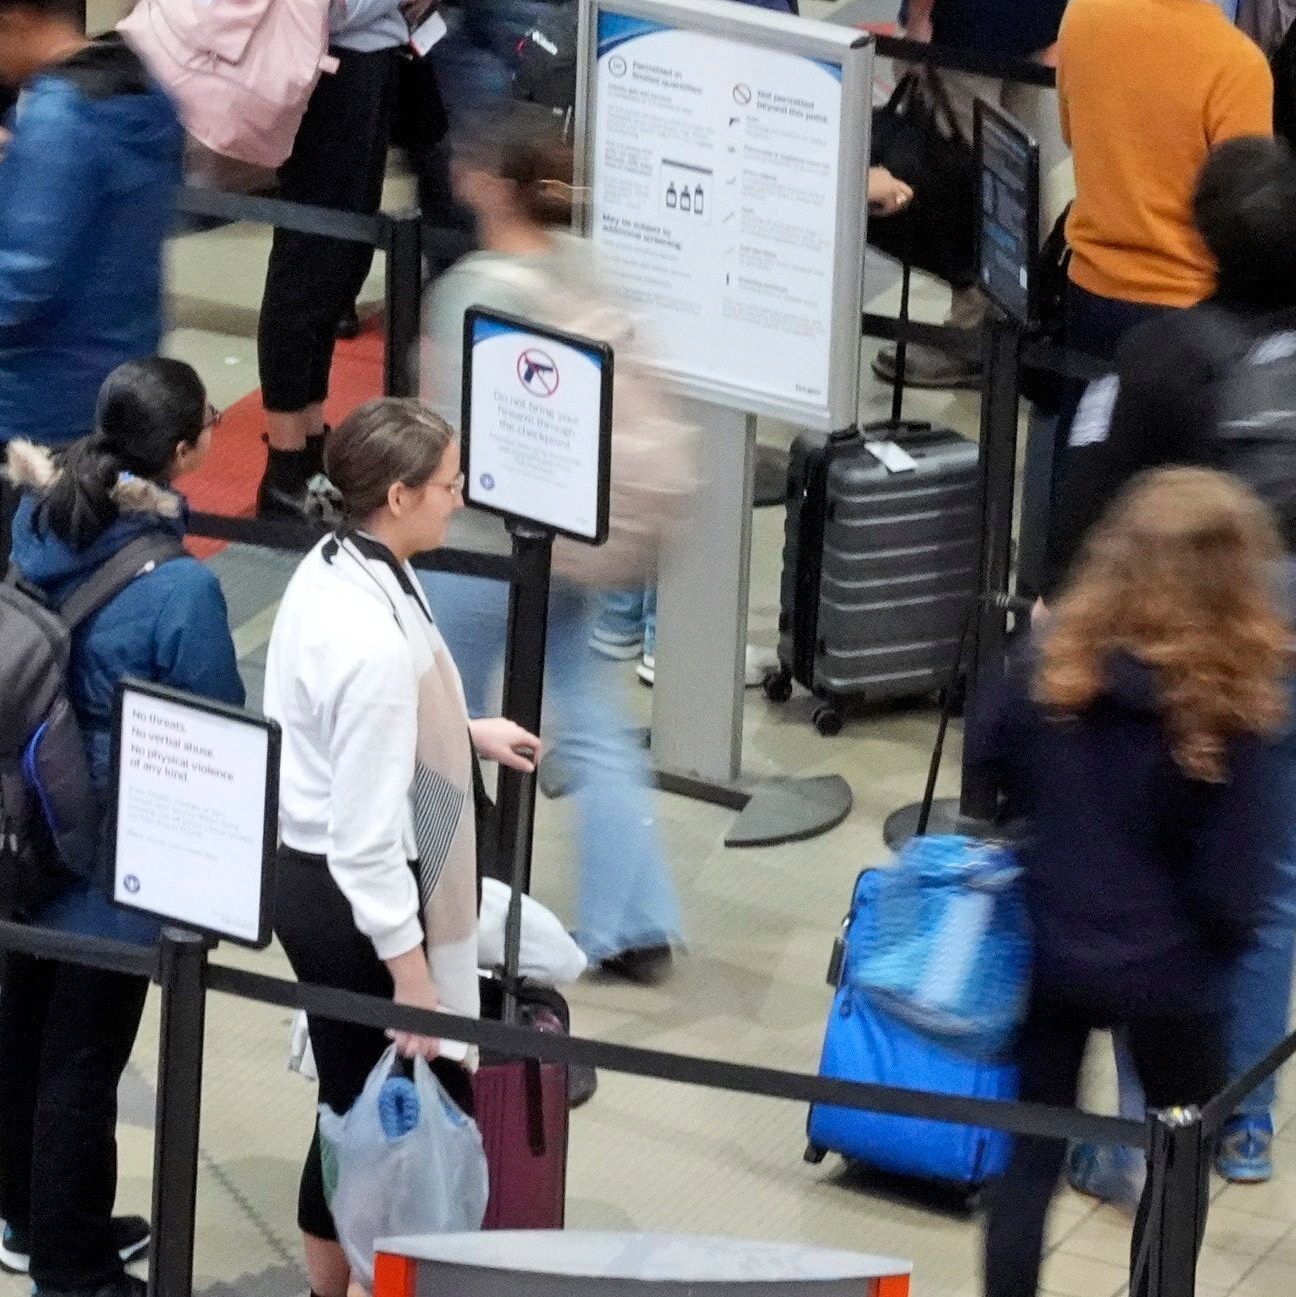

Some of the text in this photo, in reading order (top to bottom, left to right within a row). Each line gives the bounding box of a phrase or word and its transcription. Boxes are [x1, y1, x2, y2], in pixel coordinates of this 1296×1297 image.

[493, 389, 508, 402] Do
[132, 708, 186, 733] No threats.
[131, 725, 146, 739] No
[149, 731, 181, 748] verbal
[130, 743, 234, 781] No physical violence
[130, 758, 141, 768] of
[143, 761, 162, 776] any
